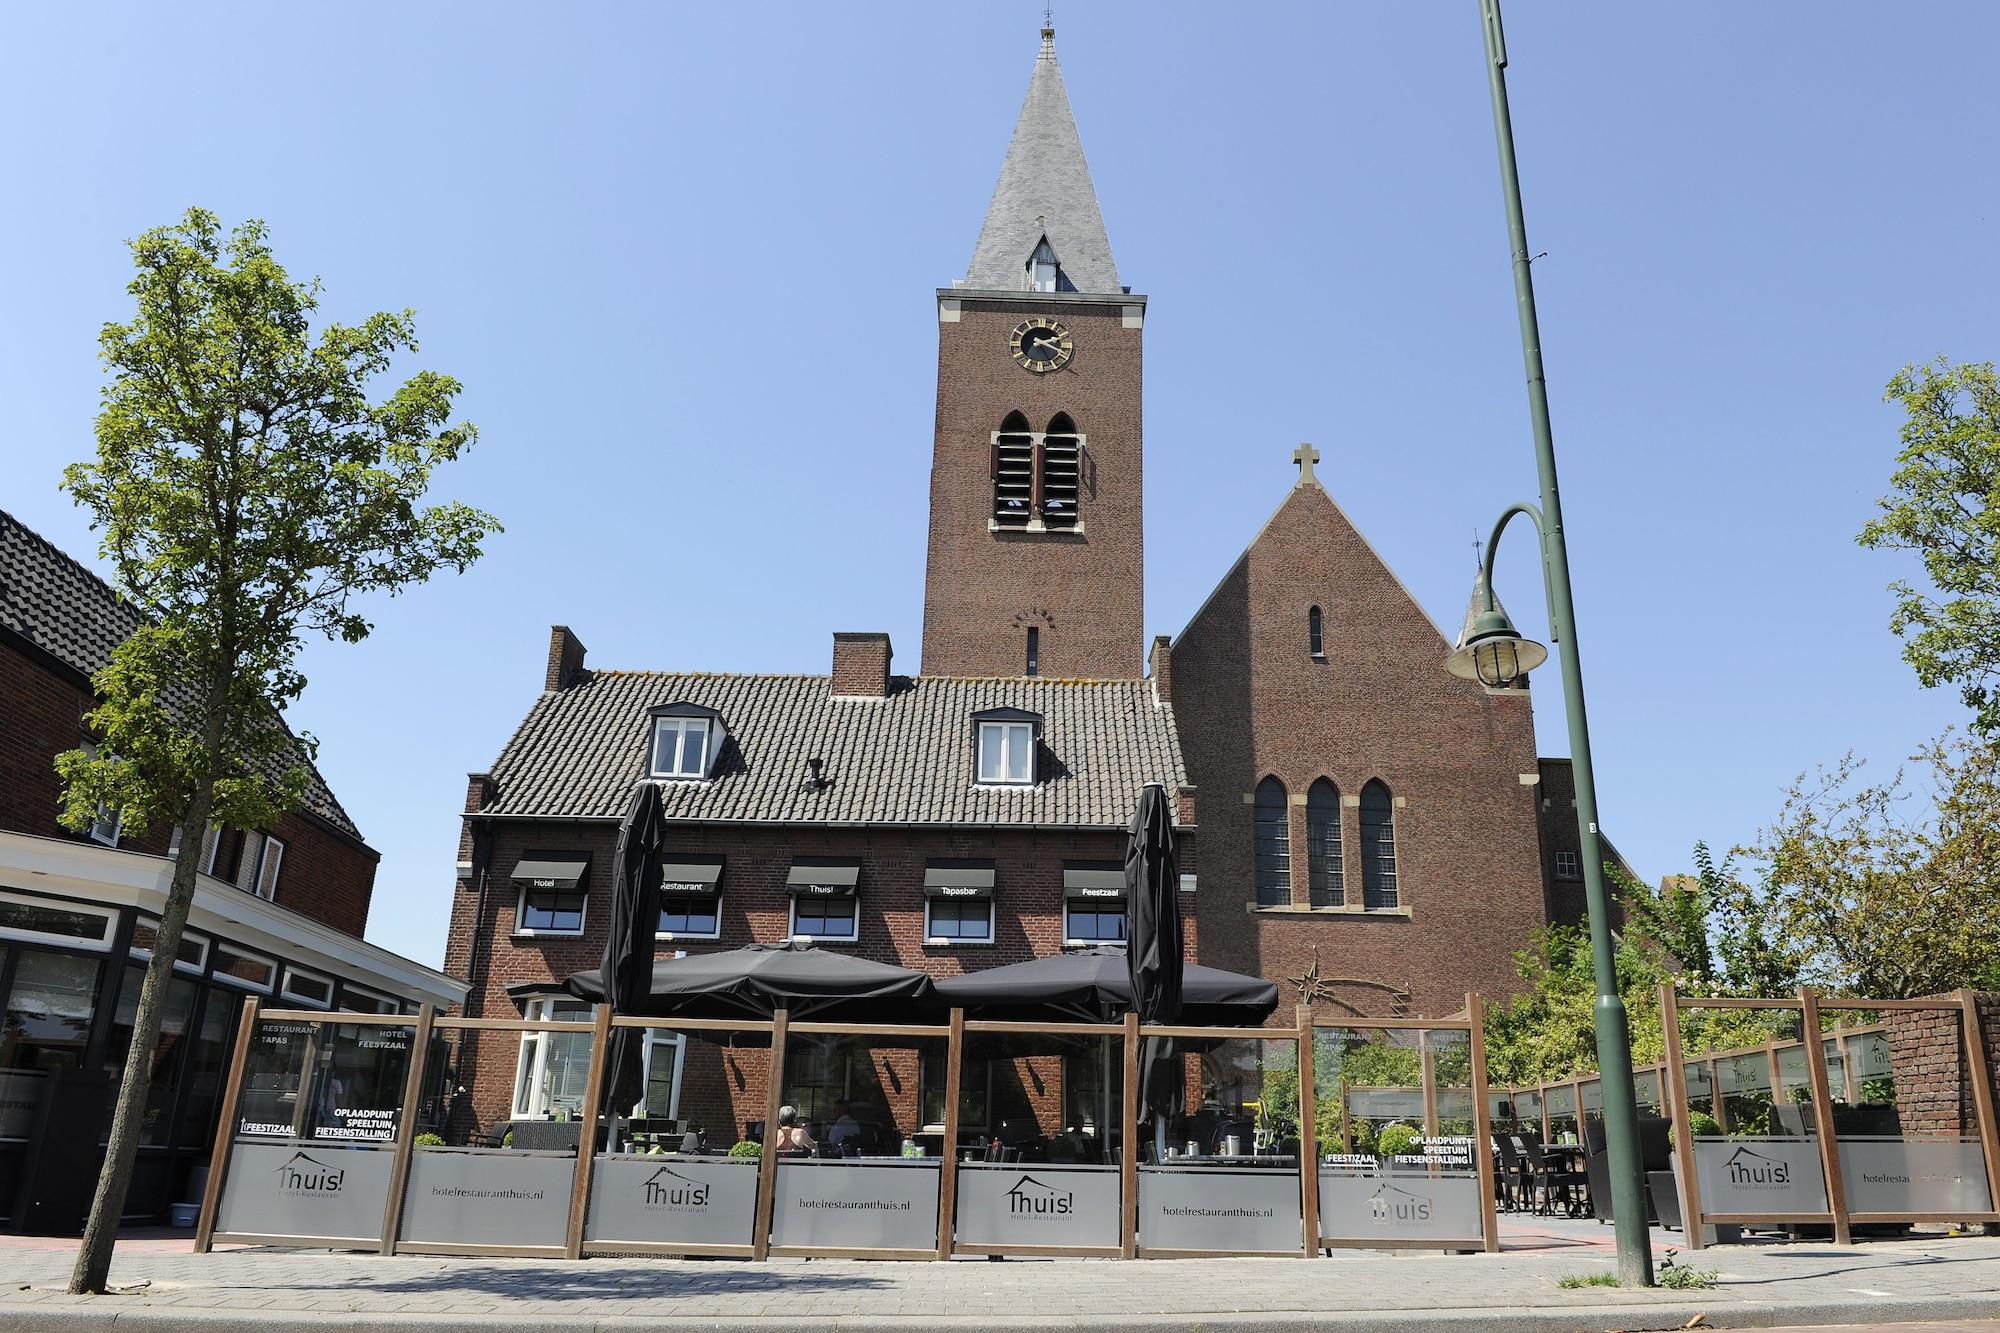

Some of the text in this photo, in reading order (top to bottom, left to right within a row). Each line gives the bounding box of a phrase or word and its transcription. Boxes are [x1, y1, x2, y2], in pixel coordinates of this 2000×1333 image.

[533, 879, 555, 888] Hotel
[809, 884, 834, 894] Thuis!
[941, 887, 978, 897] Tapasbar
[1082, 888, 1119, 897] Feestzaal
[262, 1025, 318, 1035] RESTAURANT
[379, 1030, 408, 1039] HOTEL
[261, 1036, 288, 1045] TAPAS
[358, 1041, 407, 1050] FEESTZAAL
[334, 1108, 394, 1119] OPLAADPUNT
[346, 1118, 393, 1128] SPEELTUIN
[315, 1127, 391, 1139] FIETSENSTALLING
[1409, 1136, 1467, 1146] OPLAADPUNT
[1423, 1146, 1468, 1155] SPEELTUIN
[1395, 1154, 1469, 1165] FIETSENSTALLING
[276, 1167, 345, 1192] Thuis!
[432, 1186, 544, 1200] hotelrestaurantthuis.nl
[645, 1182, 710, 1206] Thuis!
[799, 1198, 910, 1211] hotelrestaurantthuis.nl
[1009, 1191, 1073, 1214] Thuis!
[1162, 1206, 1273, 1218] hotelrestaurantthuis.nl
